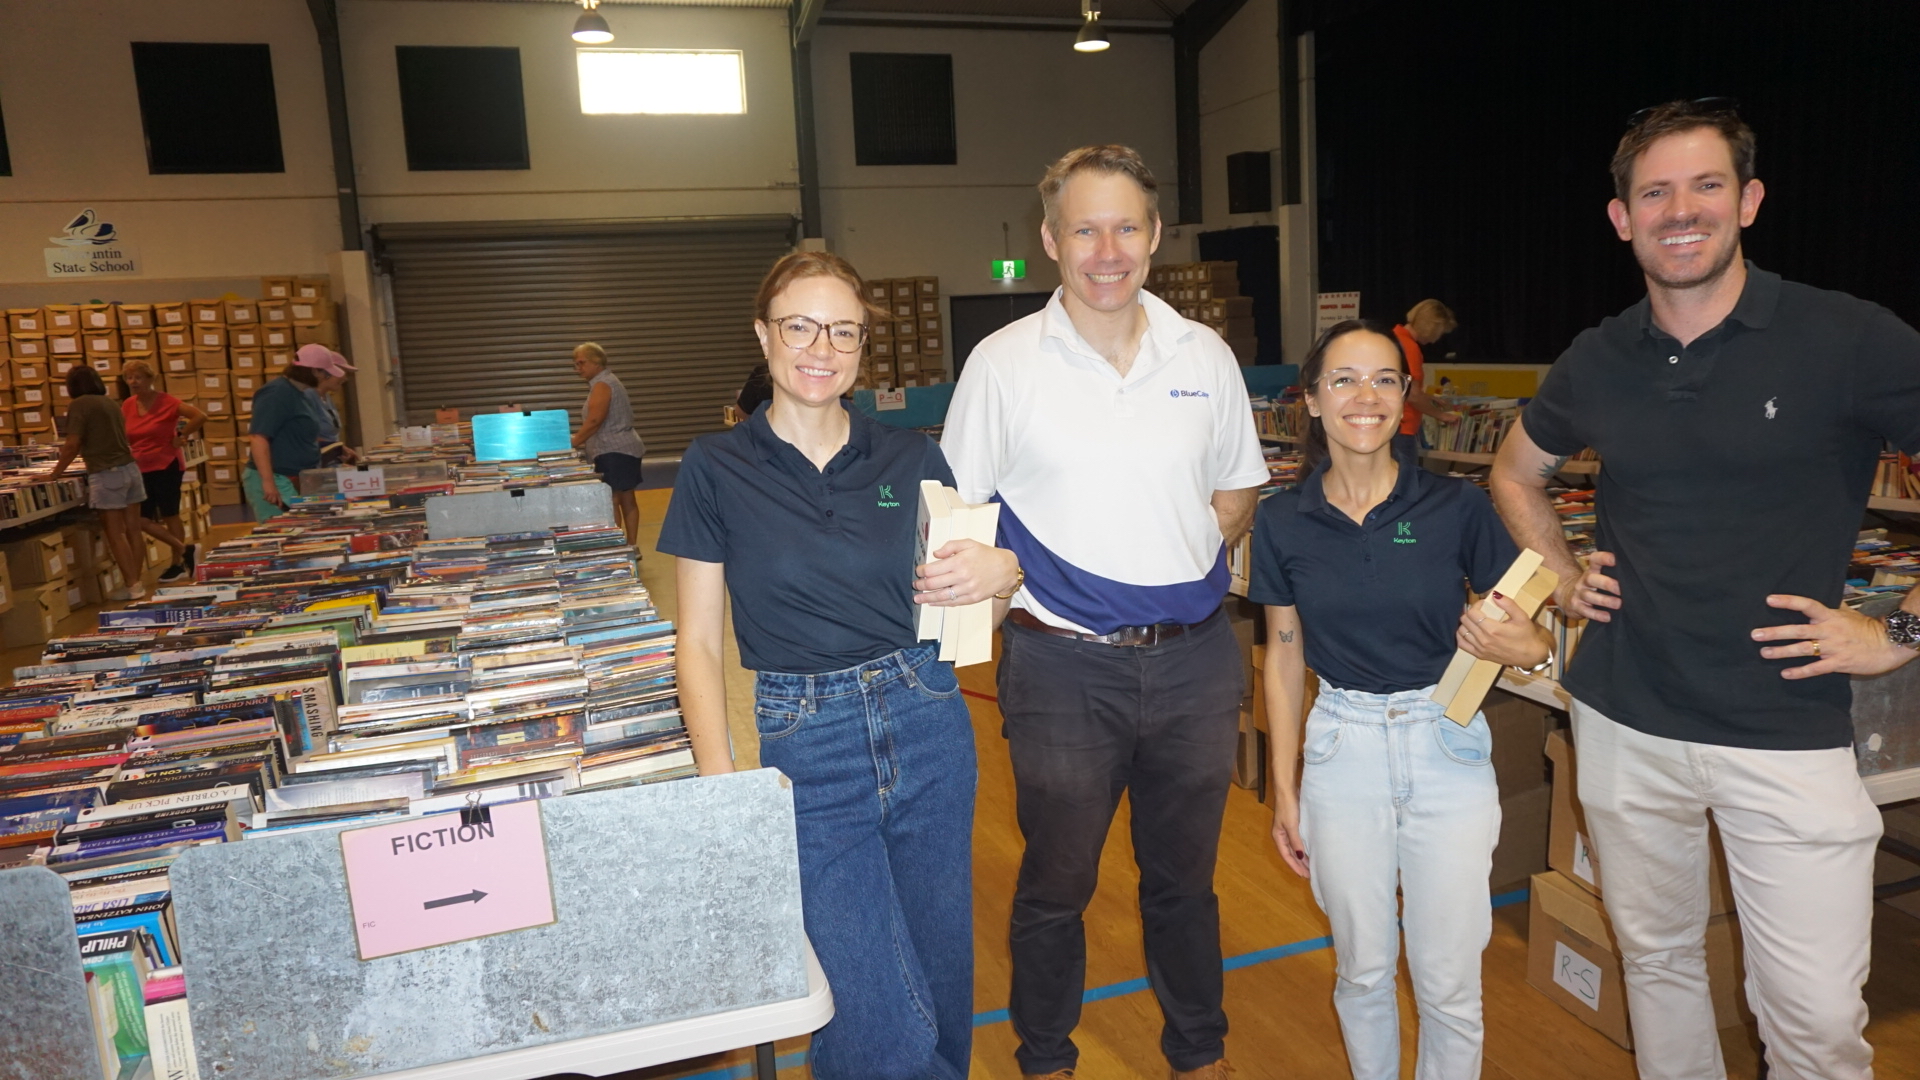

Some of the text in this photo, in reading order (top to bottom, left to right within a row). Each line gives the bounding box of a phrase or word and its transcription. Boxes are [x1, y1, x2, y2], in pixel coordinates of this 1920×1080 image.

[90, 260, 135, 272] School
[877, 500, 900, 508] Keyton
[1393, 537, 1417, 545] Keyton
[205, 697, 268, 712] JOHN GRISHAM
[160, 707, 201, 717] TESTAMENT
[302, 687, 324, 738] SMASHING
[133, 755, 182, 766] ACCUSED
[158, 768, 182, 776] CON
[136, 772, 194, 786] ABDUCTION
[176, 791, 218, 803] O'BRIEN
[128, 802, 142, 810] UP
[146, 798, 170, 808] PICK
[199, 803, 226, 811] TERRY
[154, 807, 197, 818] GOODKIND
[17, 820, 58, 831] BLOCK
[106, 836, 136, 845] KEEPER
[138, 831, 169, 840] SECRET
[391, 822, 495, 856] FICTION
[79, 841, 101, 849] JAIPU
[102, 870, 148, 881] CAMPBELL
[103, 898, 129, 908] LISA
[75, 902, 165, 920] JOHN KATZENBAC
[362, 920, 376, 929] FIC
[81, 935, 128, 953] PHILIP
[1561, 955, 1596, 1000] R-S
